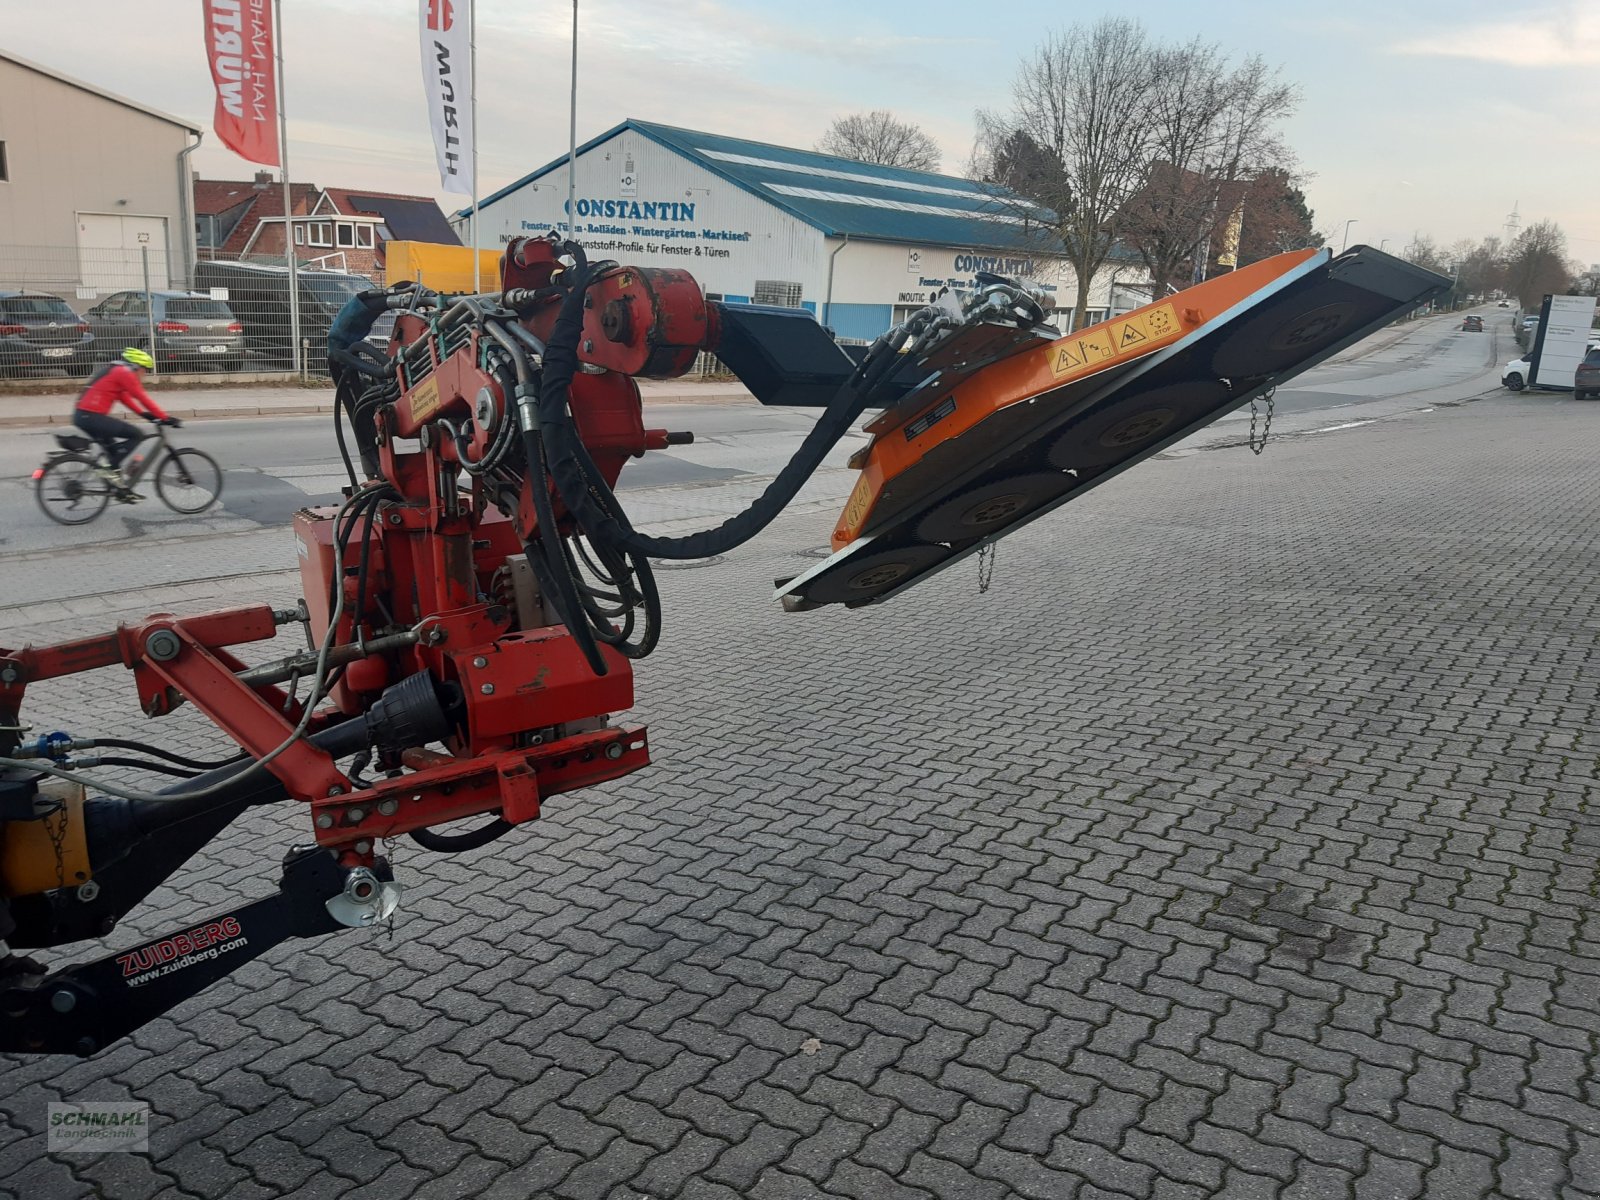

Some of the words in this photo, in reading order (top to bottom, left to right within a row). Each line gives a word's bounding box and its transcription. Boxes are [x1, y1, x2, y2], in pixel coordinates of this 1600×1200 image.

[521, 221, 552, 231] Fenster
[587, 223, 627, 235] Rolläden
[632, 226, 697, 239] Wintergärten
[702, 229, 750, 241] Markisen
[646, 242, 659, 253] für
[661, 244, 693, 255] Fenster
[694, 246, 702, 256] &
[704, 246, 730, 258] Türen
[954, 254, 1034, 276] CONSTANTIN
[898, 292, 925, 303] INOUTIC
[1154, 325, 1172, 336] STOP
[116, 917, 242, 977] ZUIDBERG
[126, 936, 249, 988] www.zuidberg.com
